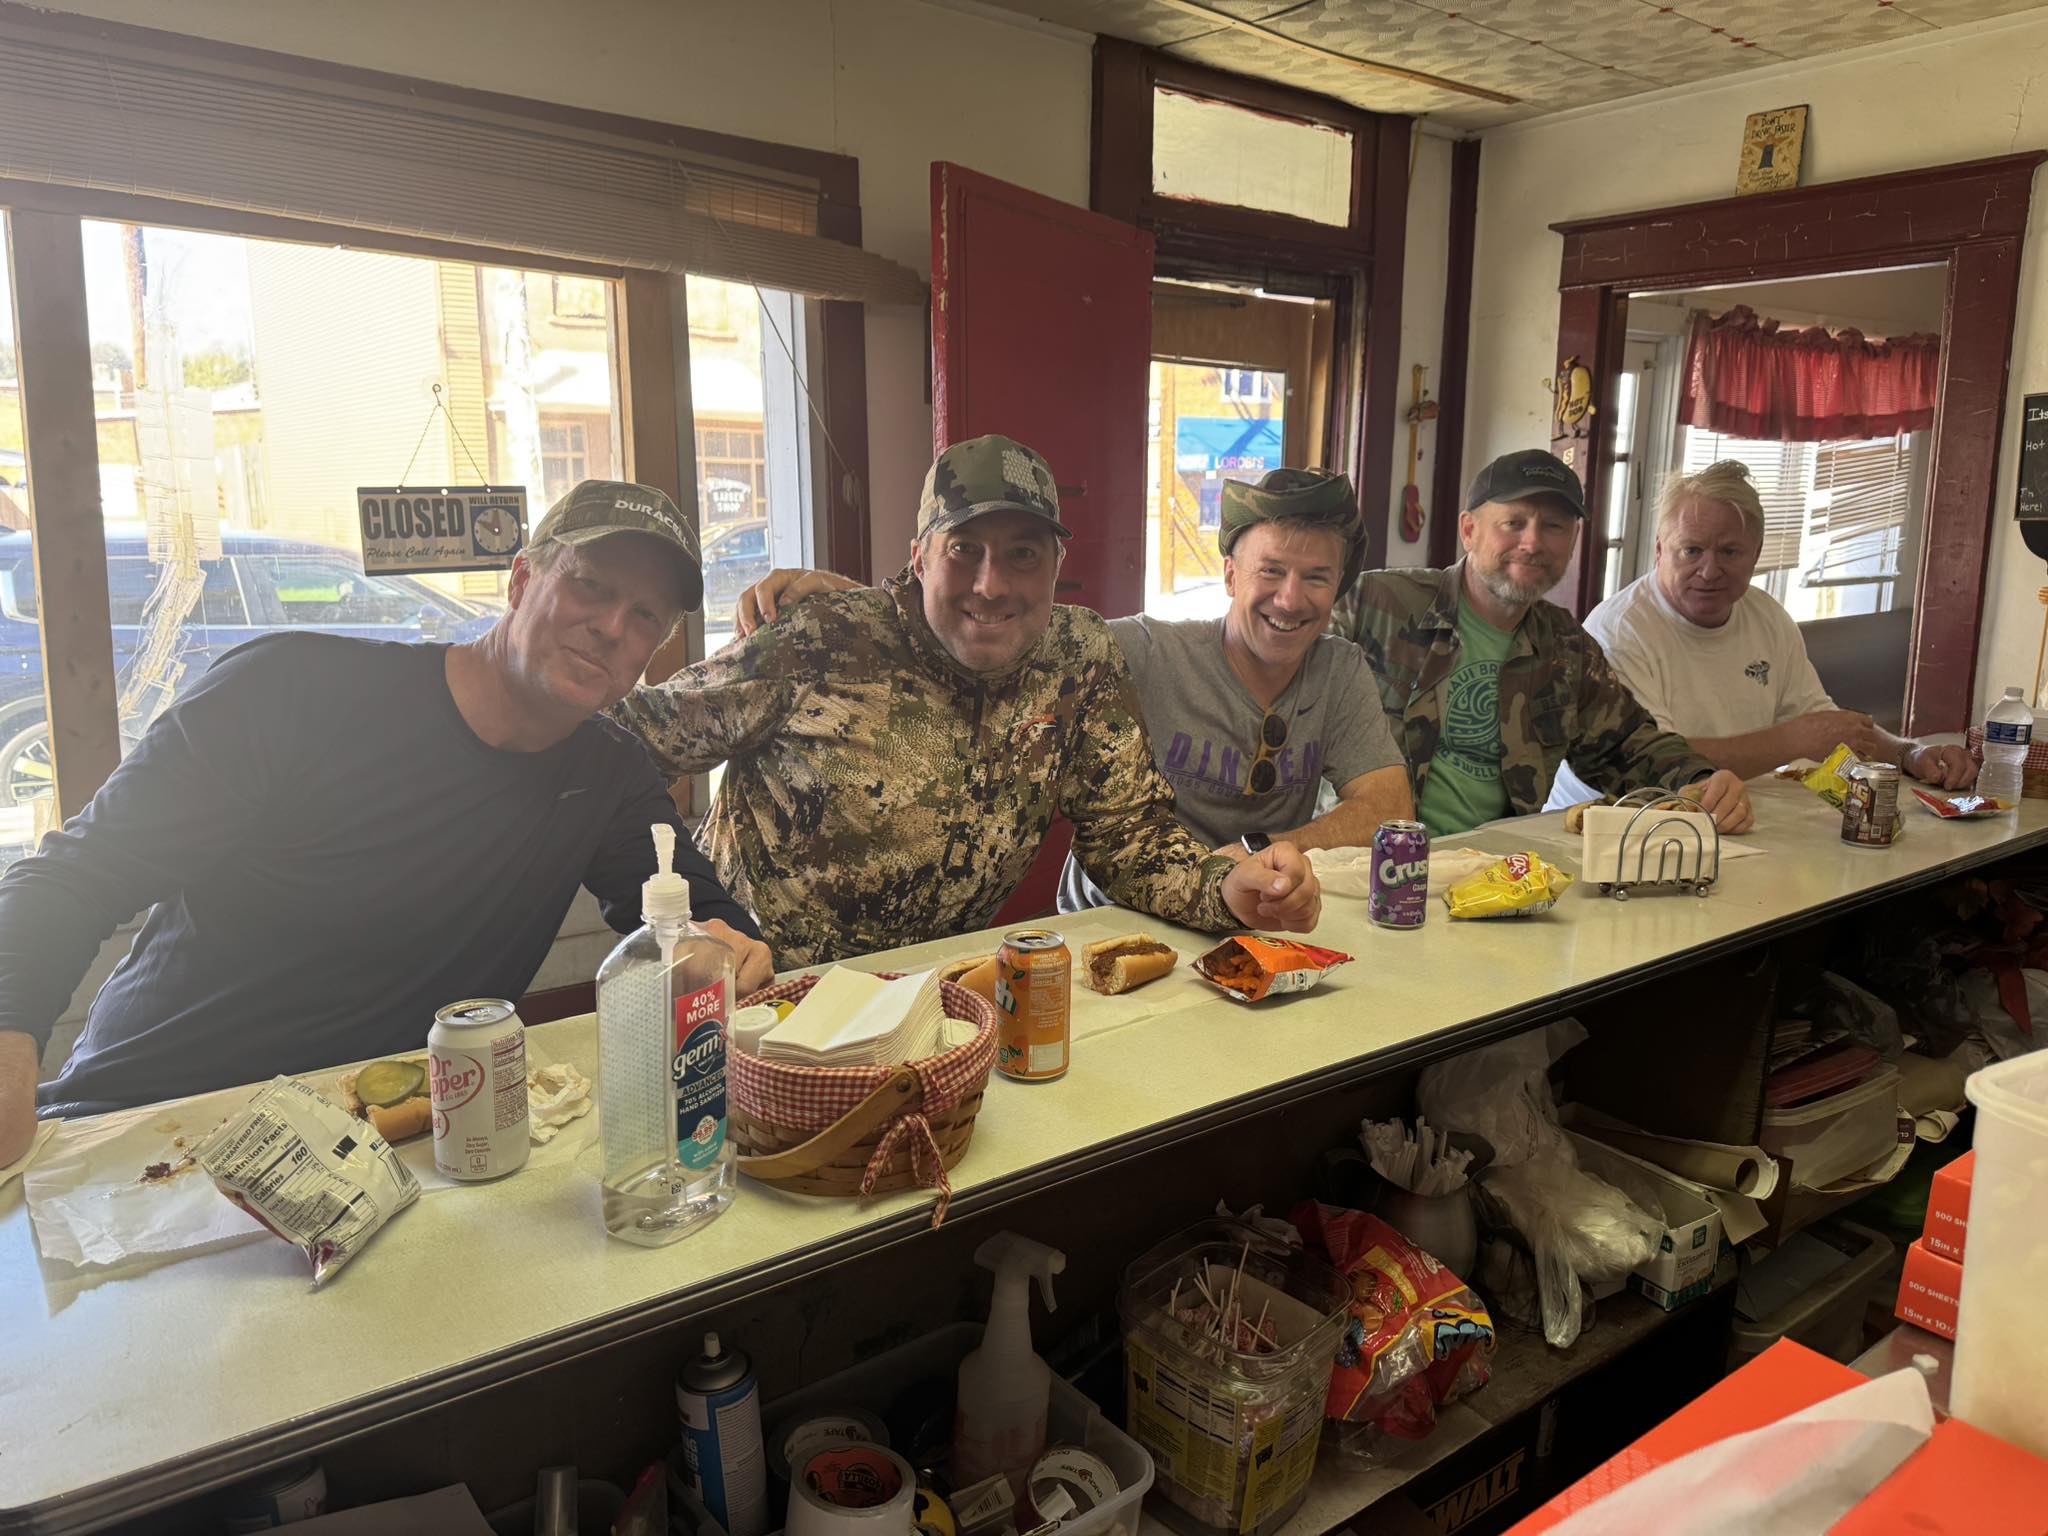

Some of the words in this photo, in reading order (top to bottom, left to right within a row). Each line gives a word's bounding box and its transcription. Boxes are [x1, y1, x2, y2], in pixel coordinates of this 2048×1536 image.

[2026, 440, 2045, 451] Hot
[469, 496, 488, 505] WILL
[489, 496, 519, 505] RETURN
[362, 497, 465, 540] CLOSED
[614, 499, 689, 546] DURACELL
[366, 547, 403, 559] Please
[404, 546, 430, 558] Call
[433, 546, 466, 557] Again
[1164, 731, 1323, 785] DINEN
[1453, 755, 1497, 777] SWELL
[1849, 782, 1869, 801] UG
[1379, 858, 1428, 886] Crus
[692, 989, 715, 1008] 40%
[687, 999, 720, 1024] MORE
[429, 1054, 451, 1077] Dr
[432, 1068, 476, 1102] pper
[683, 1070, 725, 1096] ADVANCED
[685, 1096, 697, 1106] 70%
[698, 1083, 722, 1100] ALCOHOL
[680, 1101, 699, 1115] HAND
[214, 1129, 252, 1172] GUARANTEED
[250, 1112, 266, 1131] FRES
[224, 1145, 266, 1180] Nutrition
[263, 1122, 288, 1146] Facts
[254, 1173, 285, 1201] Calories
[291, 1146, 309, 1165] 160
[1935, 1210, 1953, 1223] 500
[1954, 1217, 1968, 1228] SH
[1908, 1280, 1926, 1294] 500
[1927, 1287, 1960, 1307] SHEETS
[1433, 1451, 1526, 1533] WALT
